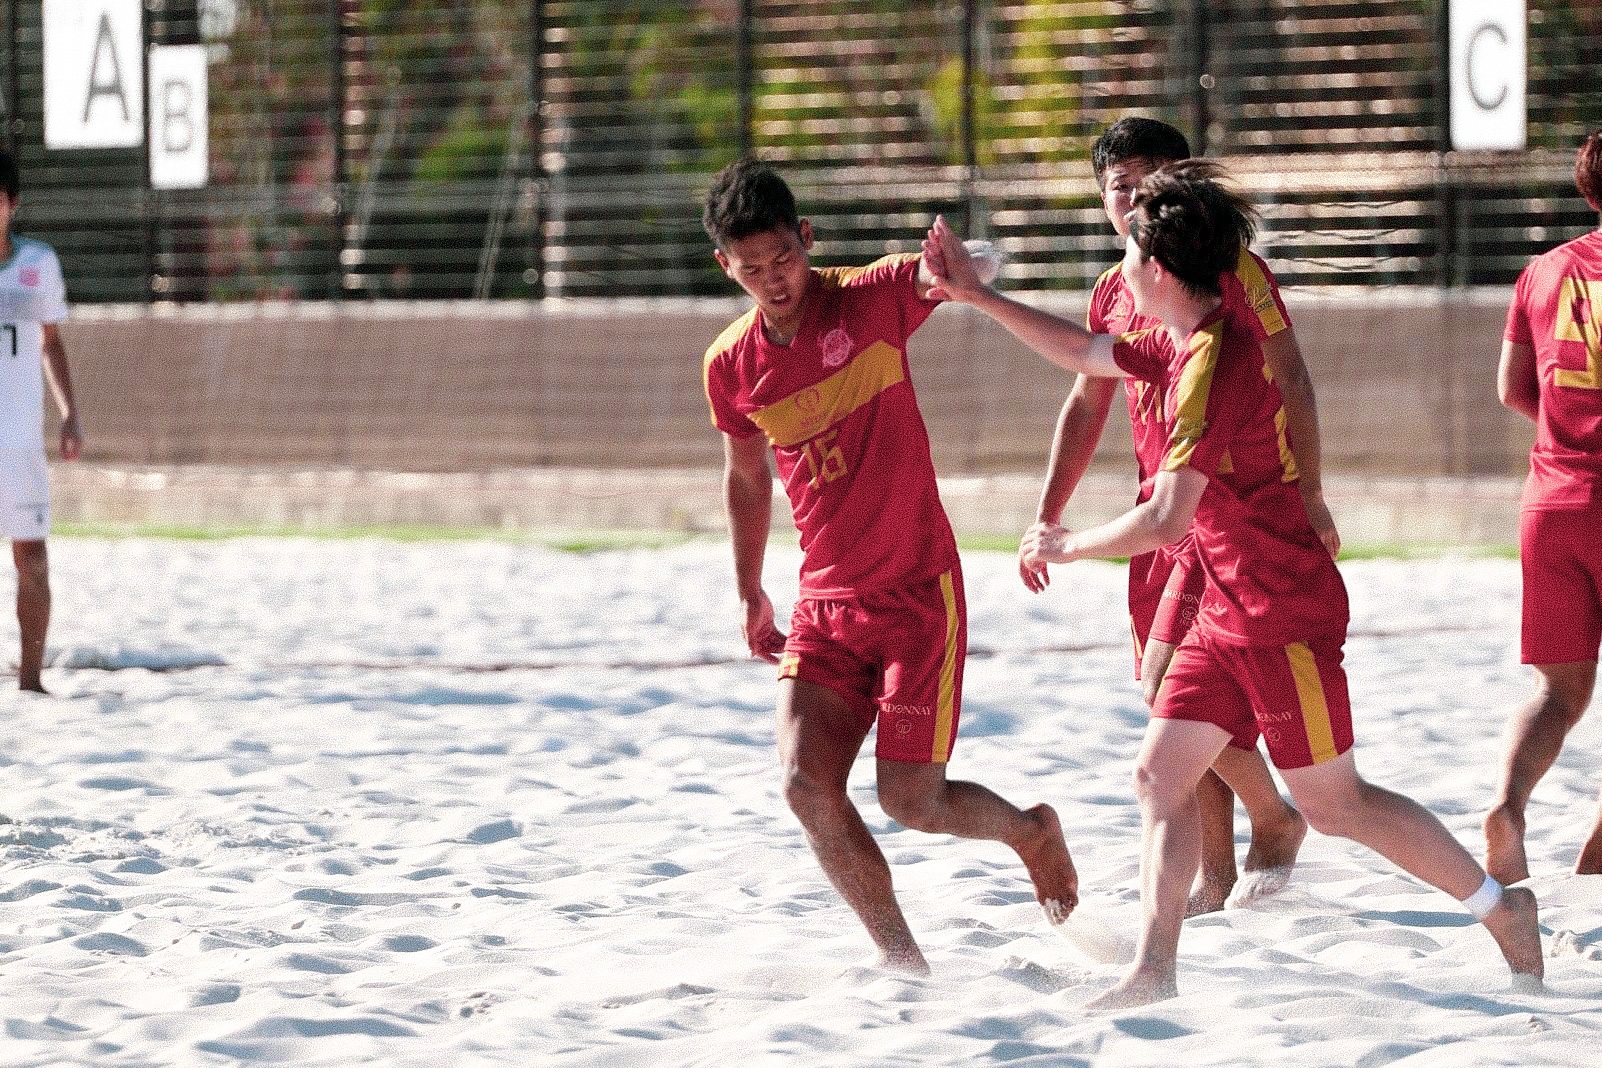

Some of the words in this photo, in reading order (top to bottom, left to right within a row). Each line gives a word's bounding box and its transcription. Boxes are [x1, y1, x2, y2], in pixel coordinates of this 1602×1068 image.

[81, 12, 131, 124] A
[1464, 21, 1509, 112] C
[160, 77, 194, 154] B
[801, 430, 848, 490] 16
